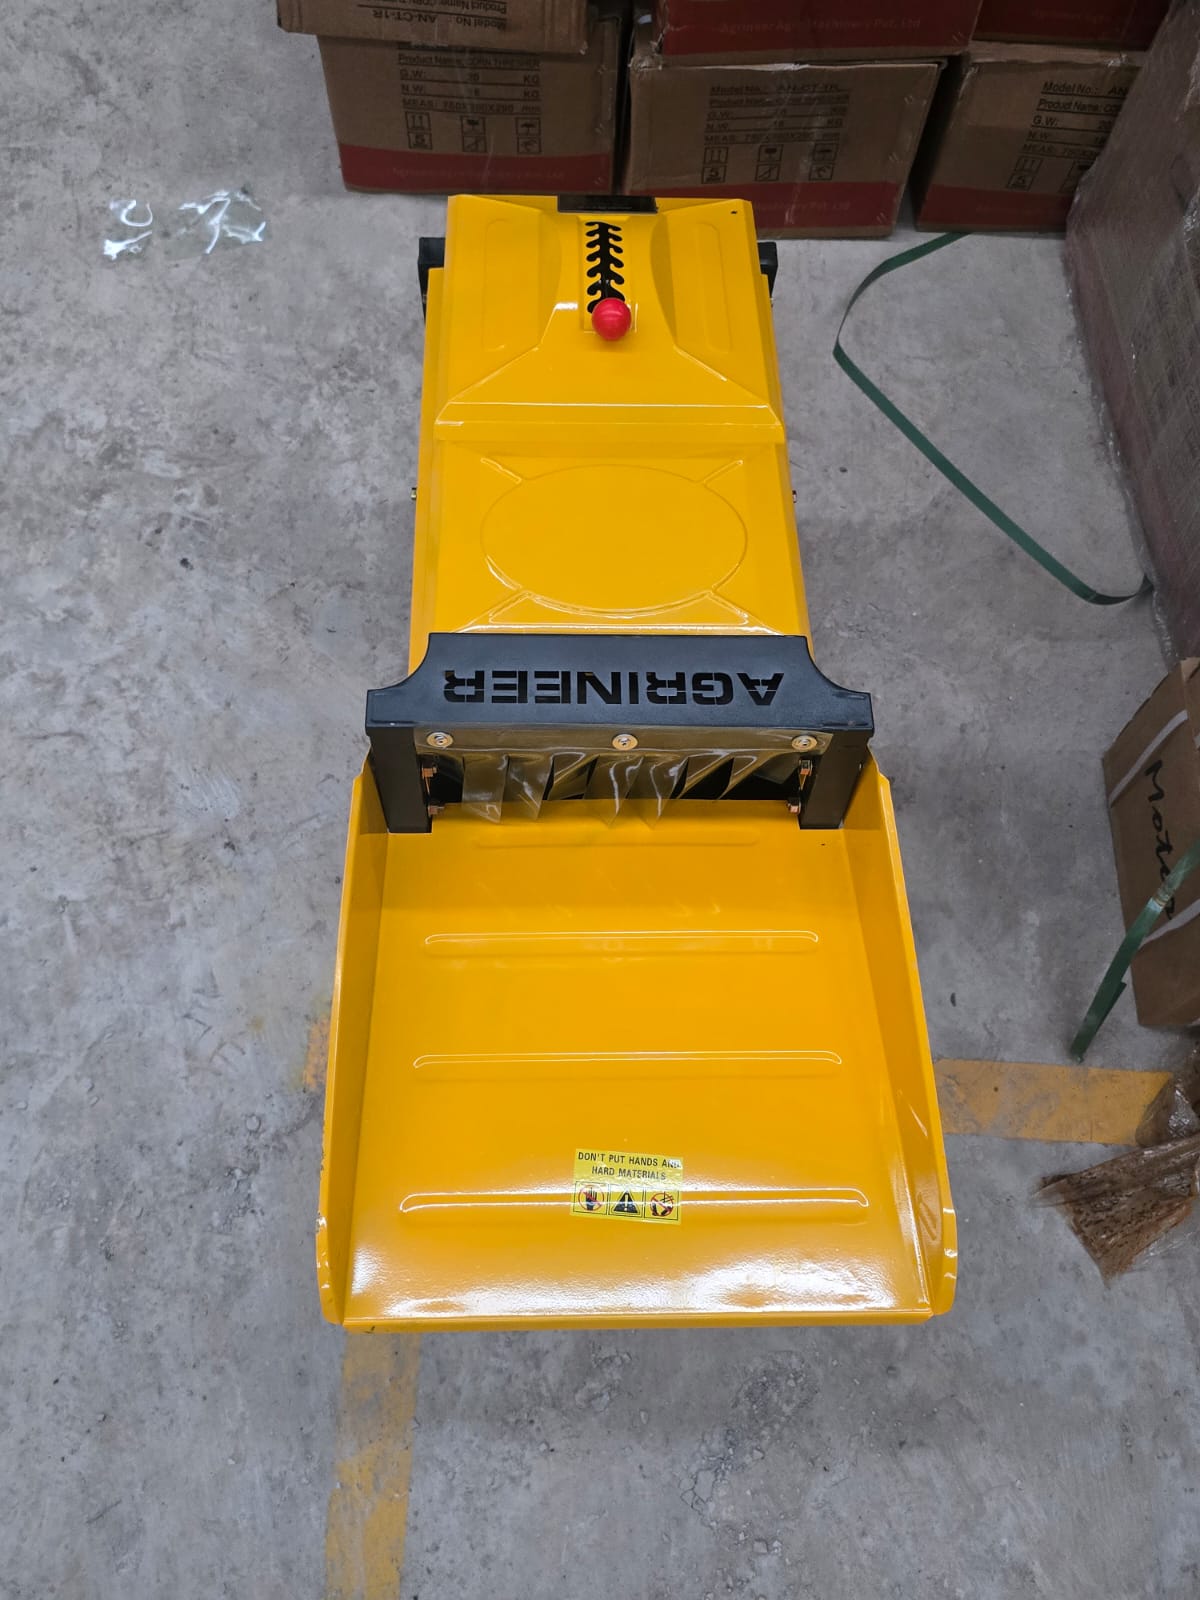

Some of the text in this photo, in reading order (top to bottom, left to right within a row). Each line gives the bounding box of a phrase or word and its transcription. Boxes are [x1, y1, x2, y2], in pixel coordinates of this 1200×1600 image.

[372, 9, 438, 24] AN-CT-1R
[1043, 81, 1075, 93] Model
[443, 669, 785, 706] AGRINEER
[577, 1151, 606, 1162] DON'T
[608, 1154, 626, 1164] PUT
[628, 1156, 658, 1167] HANDS
[591, 1165, 666, 1181] HARD MATERIALS
